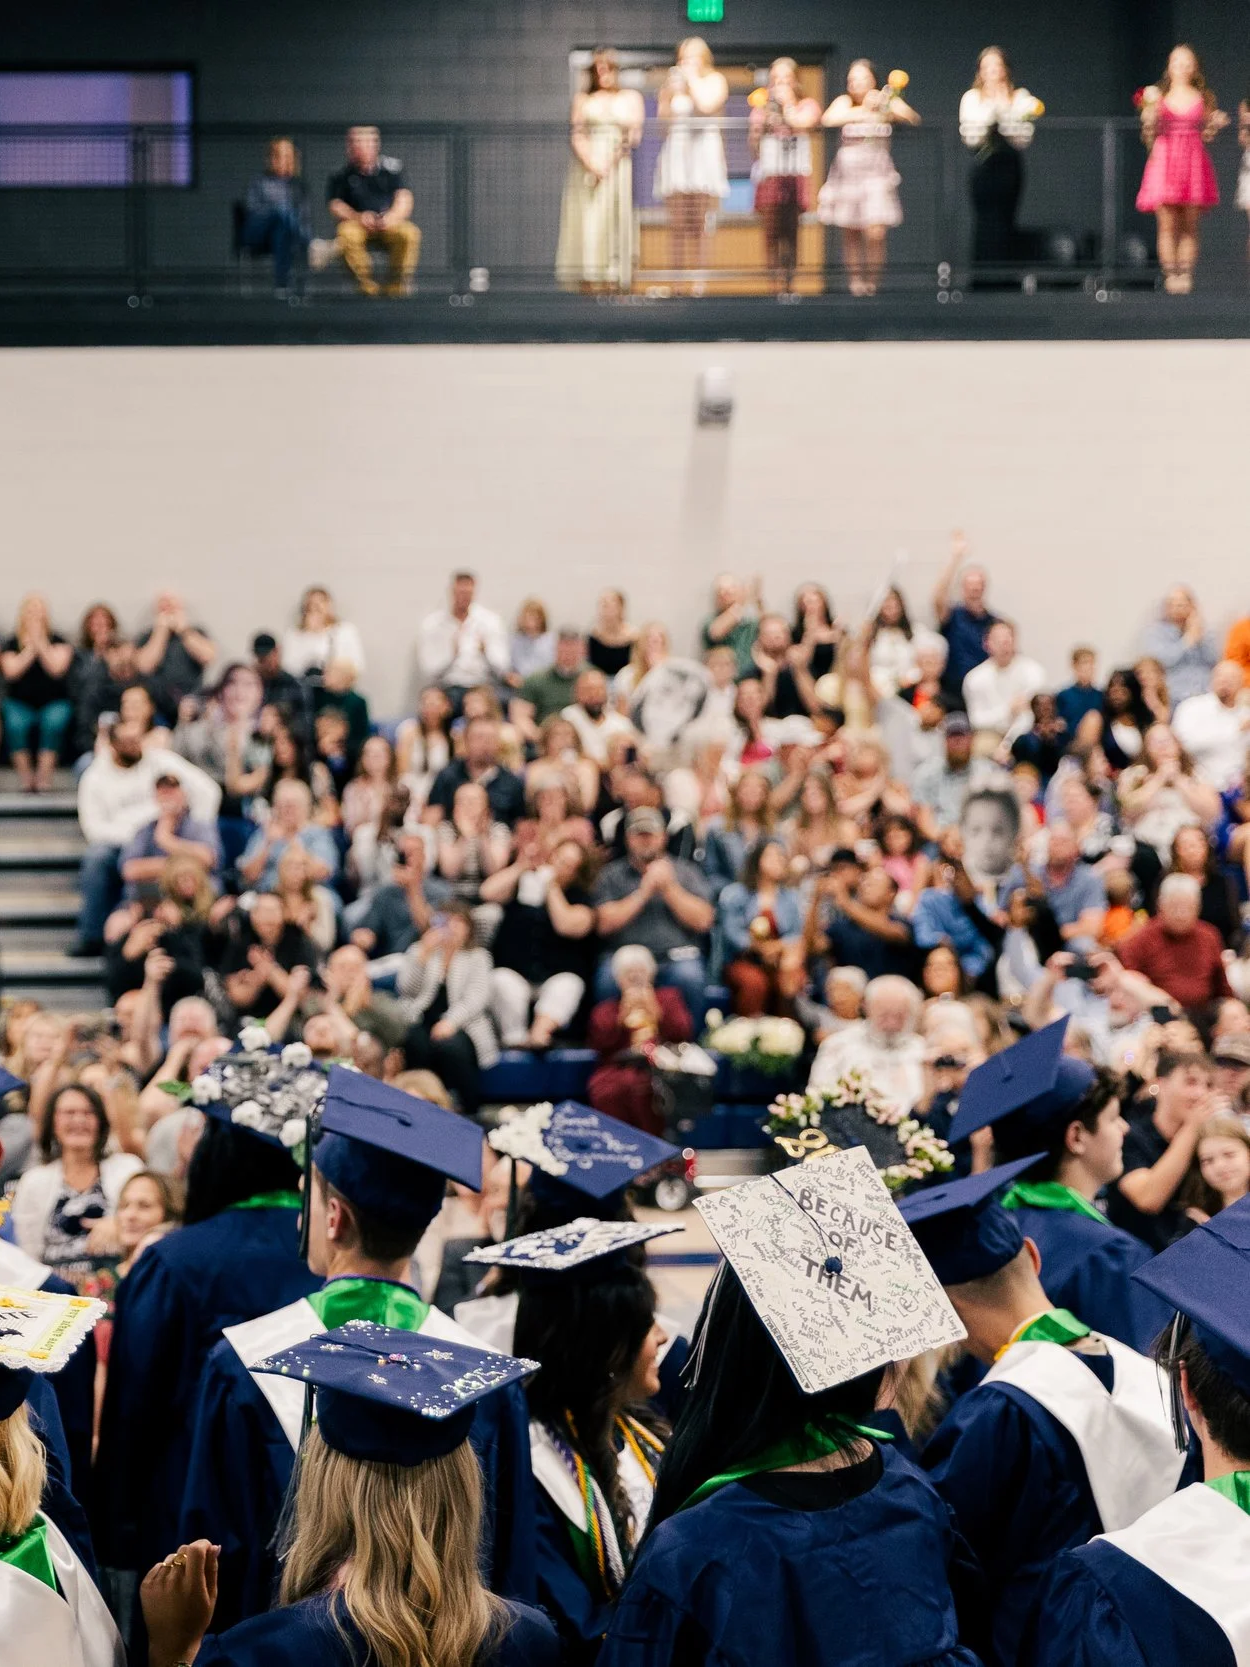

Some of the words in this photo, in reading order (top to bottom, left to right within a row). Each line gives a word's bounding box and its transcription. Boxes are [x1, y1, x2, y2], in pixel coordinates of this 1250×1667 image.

[799, 1188, 898, 1252] BECAUSE
[828, 1230, 858, 1252] OF
[800, 1254, 873, 1311] THEM
